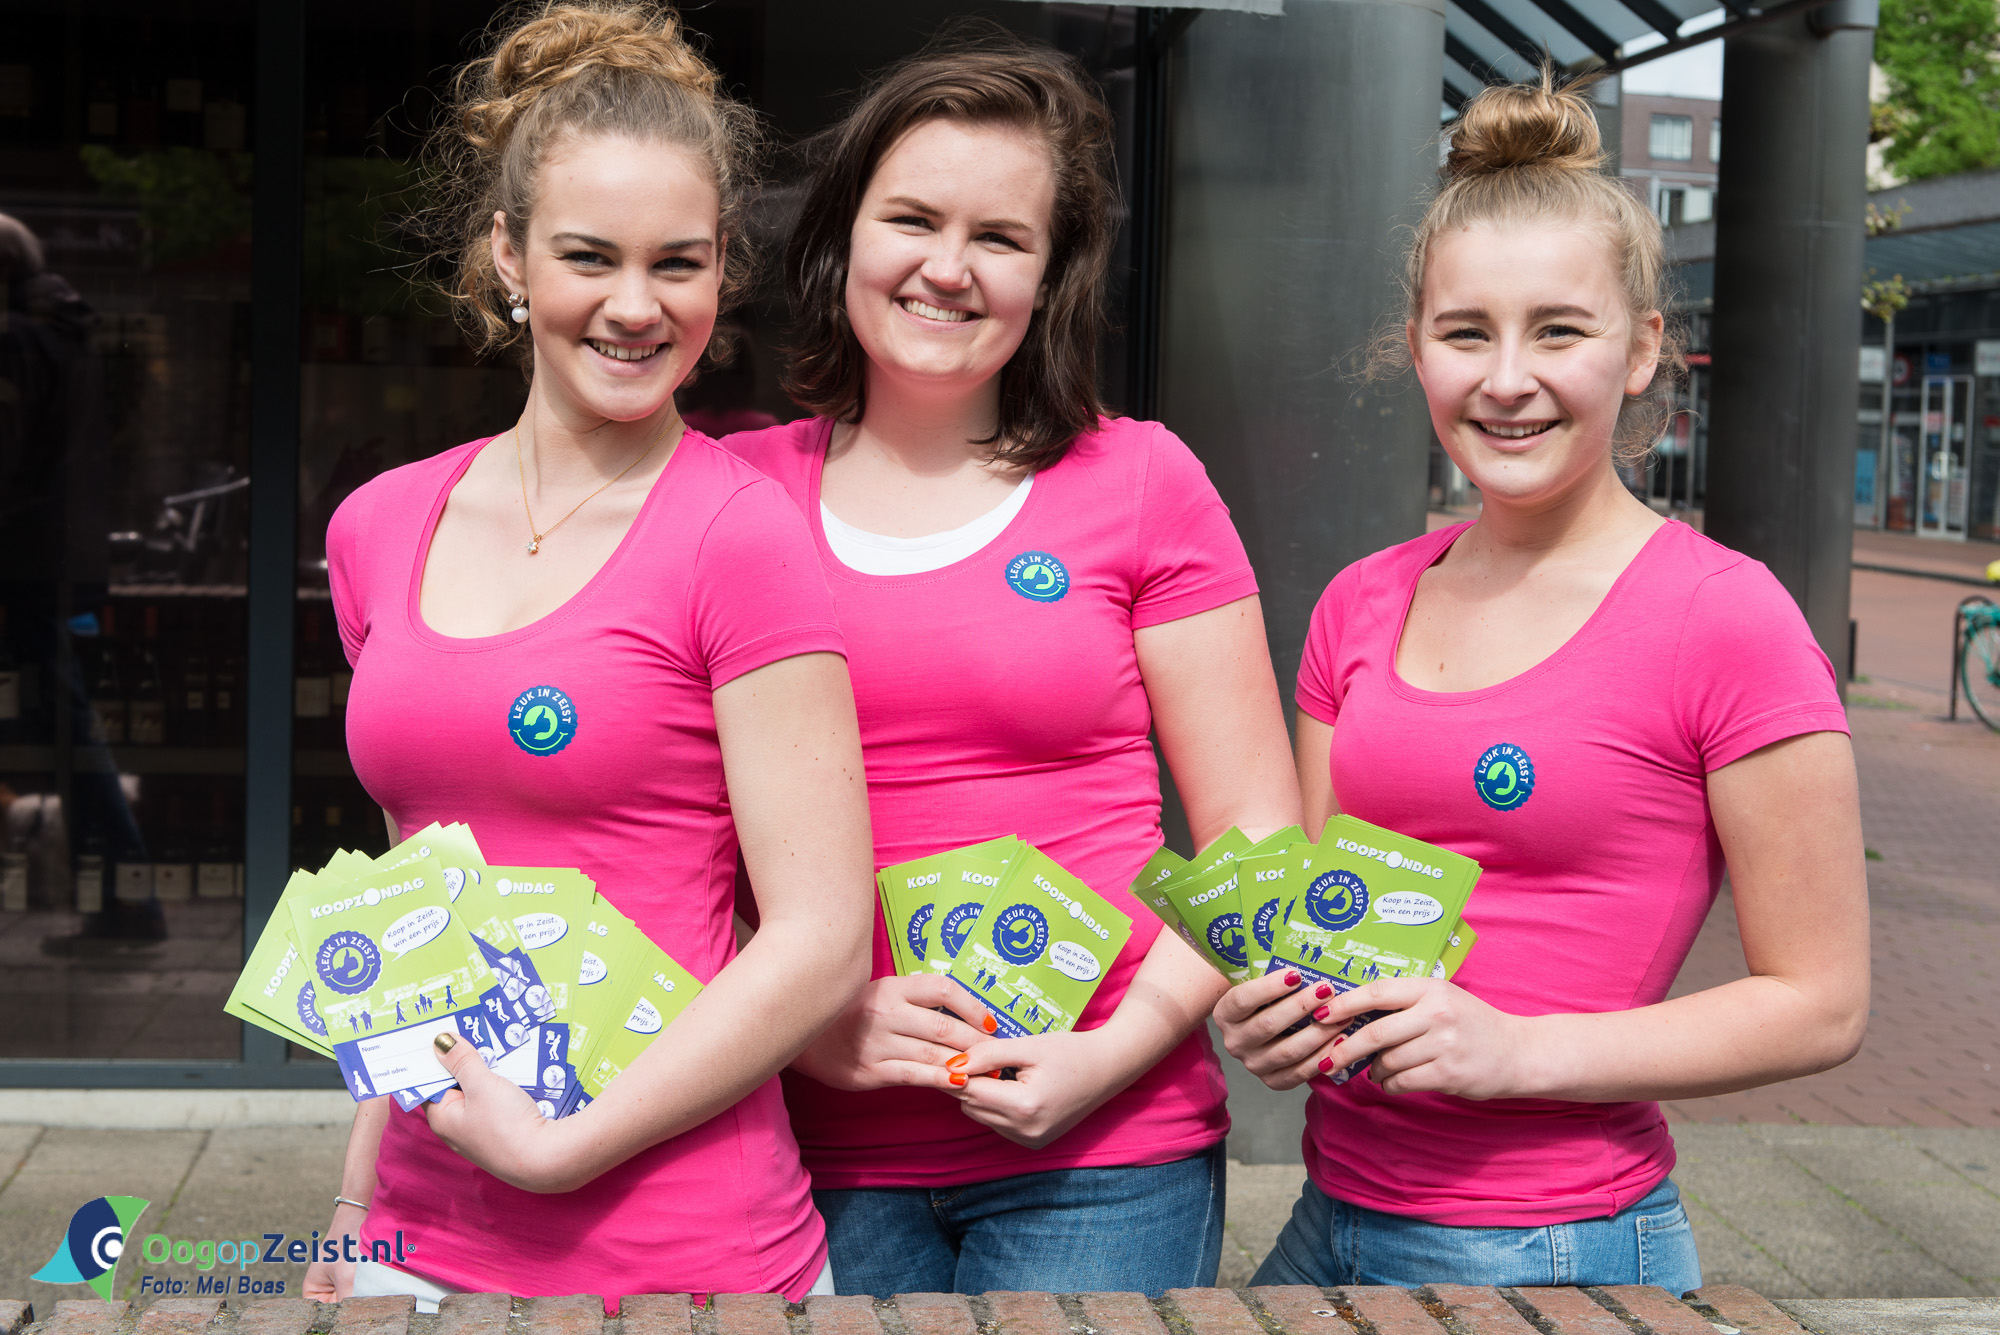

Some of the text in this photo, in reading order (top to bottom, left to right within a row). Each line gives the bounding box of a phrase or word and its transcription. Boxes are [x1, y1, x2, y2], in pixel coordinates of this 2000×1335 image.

[1010, 558, 1028, 579] LEUK
[1044, 558, 1065, 584] ZEIST
[513, 688, 571, 724] LEUK IN ZEIST
[1478, 747, 1529, 784] LEUK IN ZEIST
[1311, 874, 1363, 912] LEUK IN ZEIST
[1382, 896, 1402, 906] Koop
[1413, 898, 1435, 907] Zeist,
[946, 907, 980, 932] LEUK IN
[1258, 906, 1274, 932] LEUK
[1412, 908, 1430, 918] prijs
[386, 926, 406, 939] Koop
[393, 938, 408, 948] win
[408, 930, 422, 940] een
[423, 920, 440, 934] prijs
[539, 928, 556, 939] prijs
[911, 914, 925, 941] LEUK
[1001, 908, 1045, 951] LEUK IN ZEIST
[1211, 926, 1222, 949] LEUK
[1218, 918, 1231, 928] IN
[321, 936, 375, 972] LEUK IN ZEIST
[1057, 943, 1072, 955] Koop
[263, 941, 299, 998] KOOPZ
[1054, 954, 1064, 963] win
[1065, 959, 1075, 968] een
[1075, 965, 1090, 975] prijs
[1274, 958, 1284, 967] Uw
[302, 988, 322, 1029] LEUK IN
[631, 1014, 649, 1026] prijs
[996, 1012, 1017, 1031] vandaag
[361, 1044, 381, 1053] Naam:
